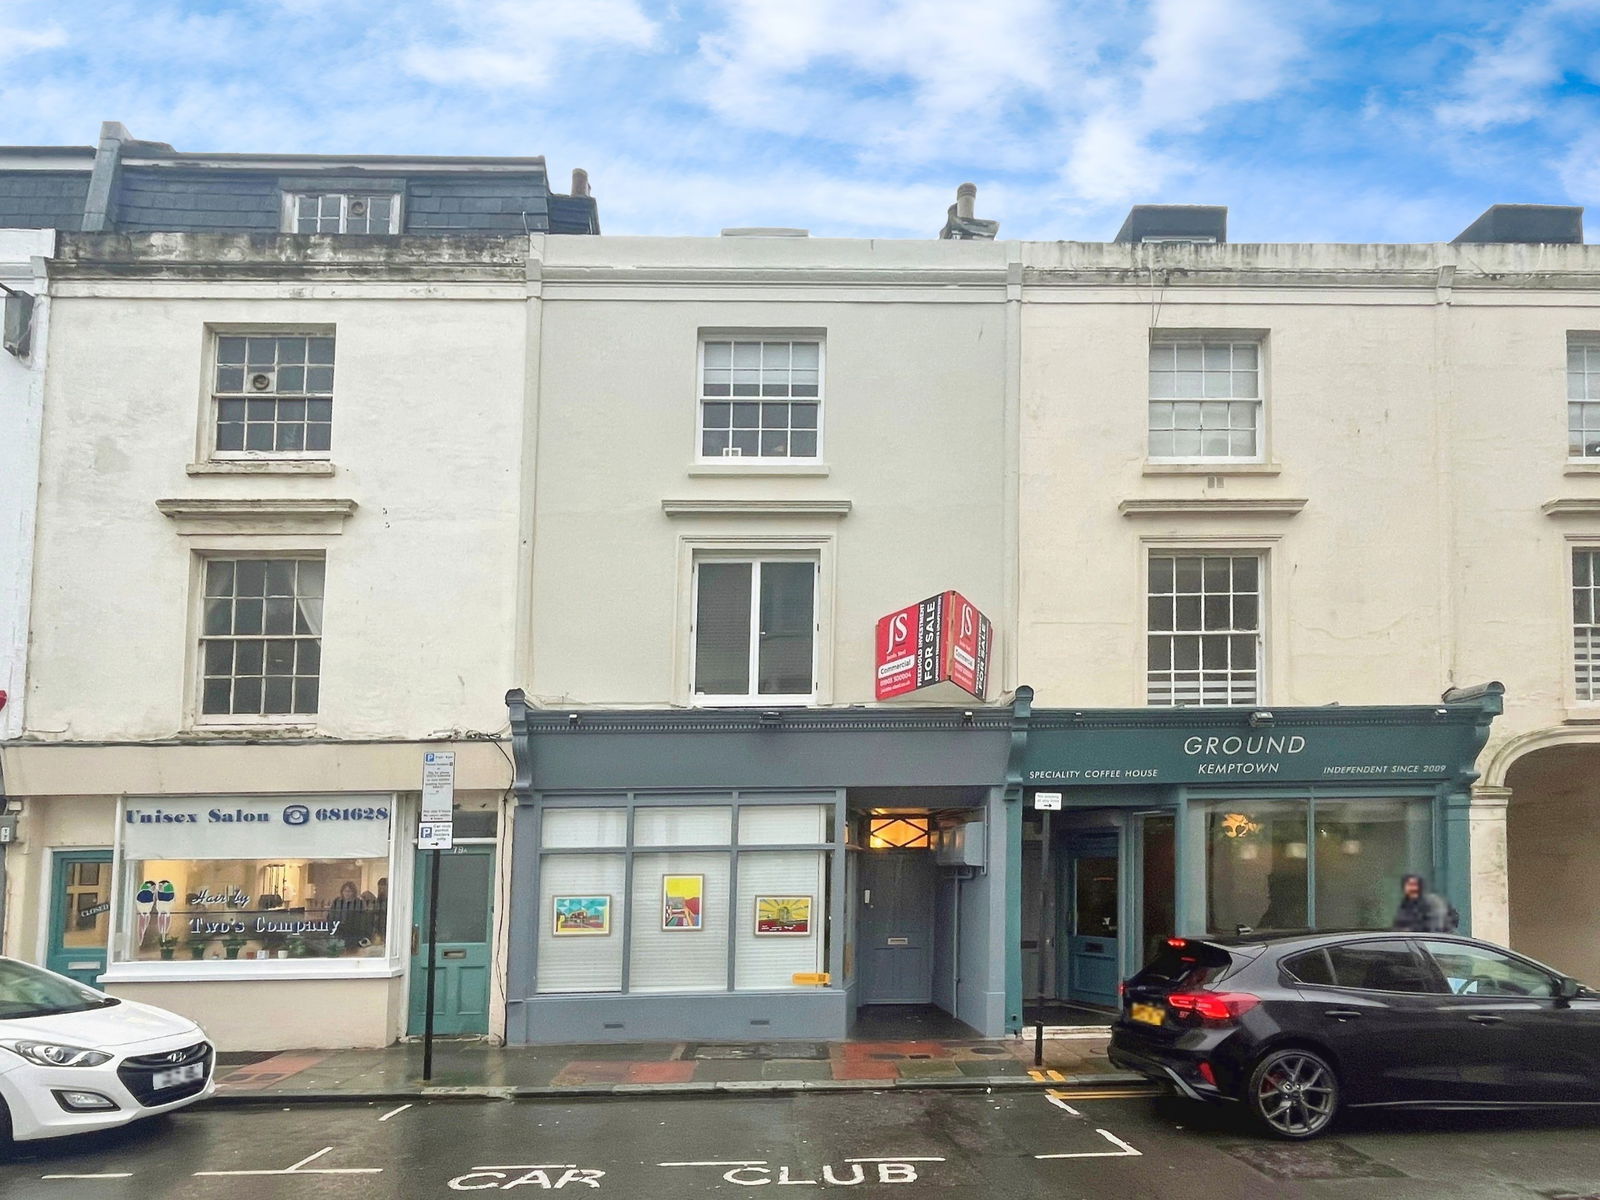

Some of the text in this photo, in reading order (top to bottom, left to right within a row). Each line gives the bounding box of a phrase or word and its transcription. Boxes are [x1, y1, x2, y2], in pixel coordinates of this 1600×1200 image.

[925, 602, 935, 680] FOR SALE
[880, 658, 912, 675] Commercial
[1184, 736, 1306, 755] GROUND
[1029, 769, 1158, 779] SPECIALITY COFFEE HOUSE
[1198, 763, 1279, 774] KEMPTOWN
[1323, 766, 1388, 774] INDEPENDENT
[126, 807, 389, 824] Unisex Salon 681628
[192, 889, 251, 908] Hair by
[189, 917, 341, 935] Two's Company
[447, 1164, 918, 1190] CAR CLUB
